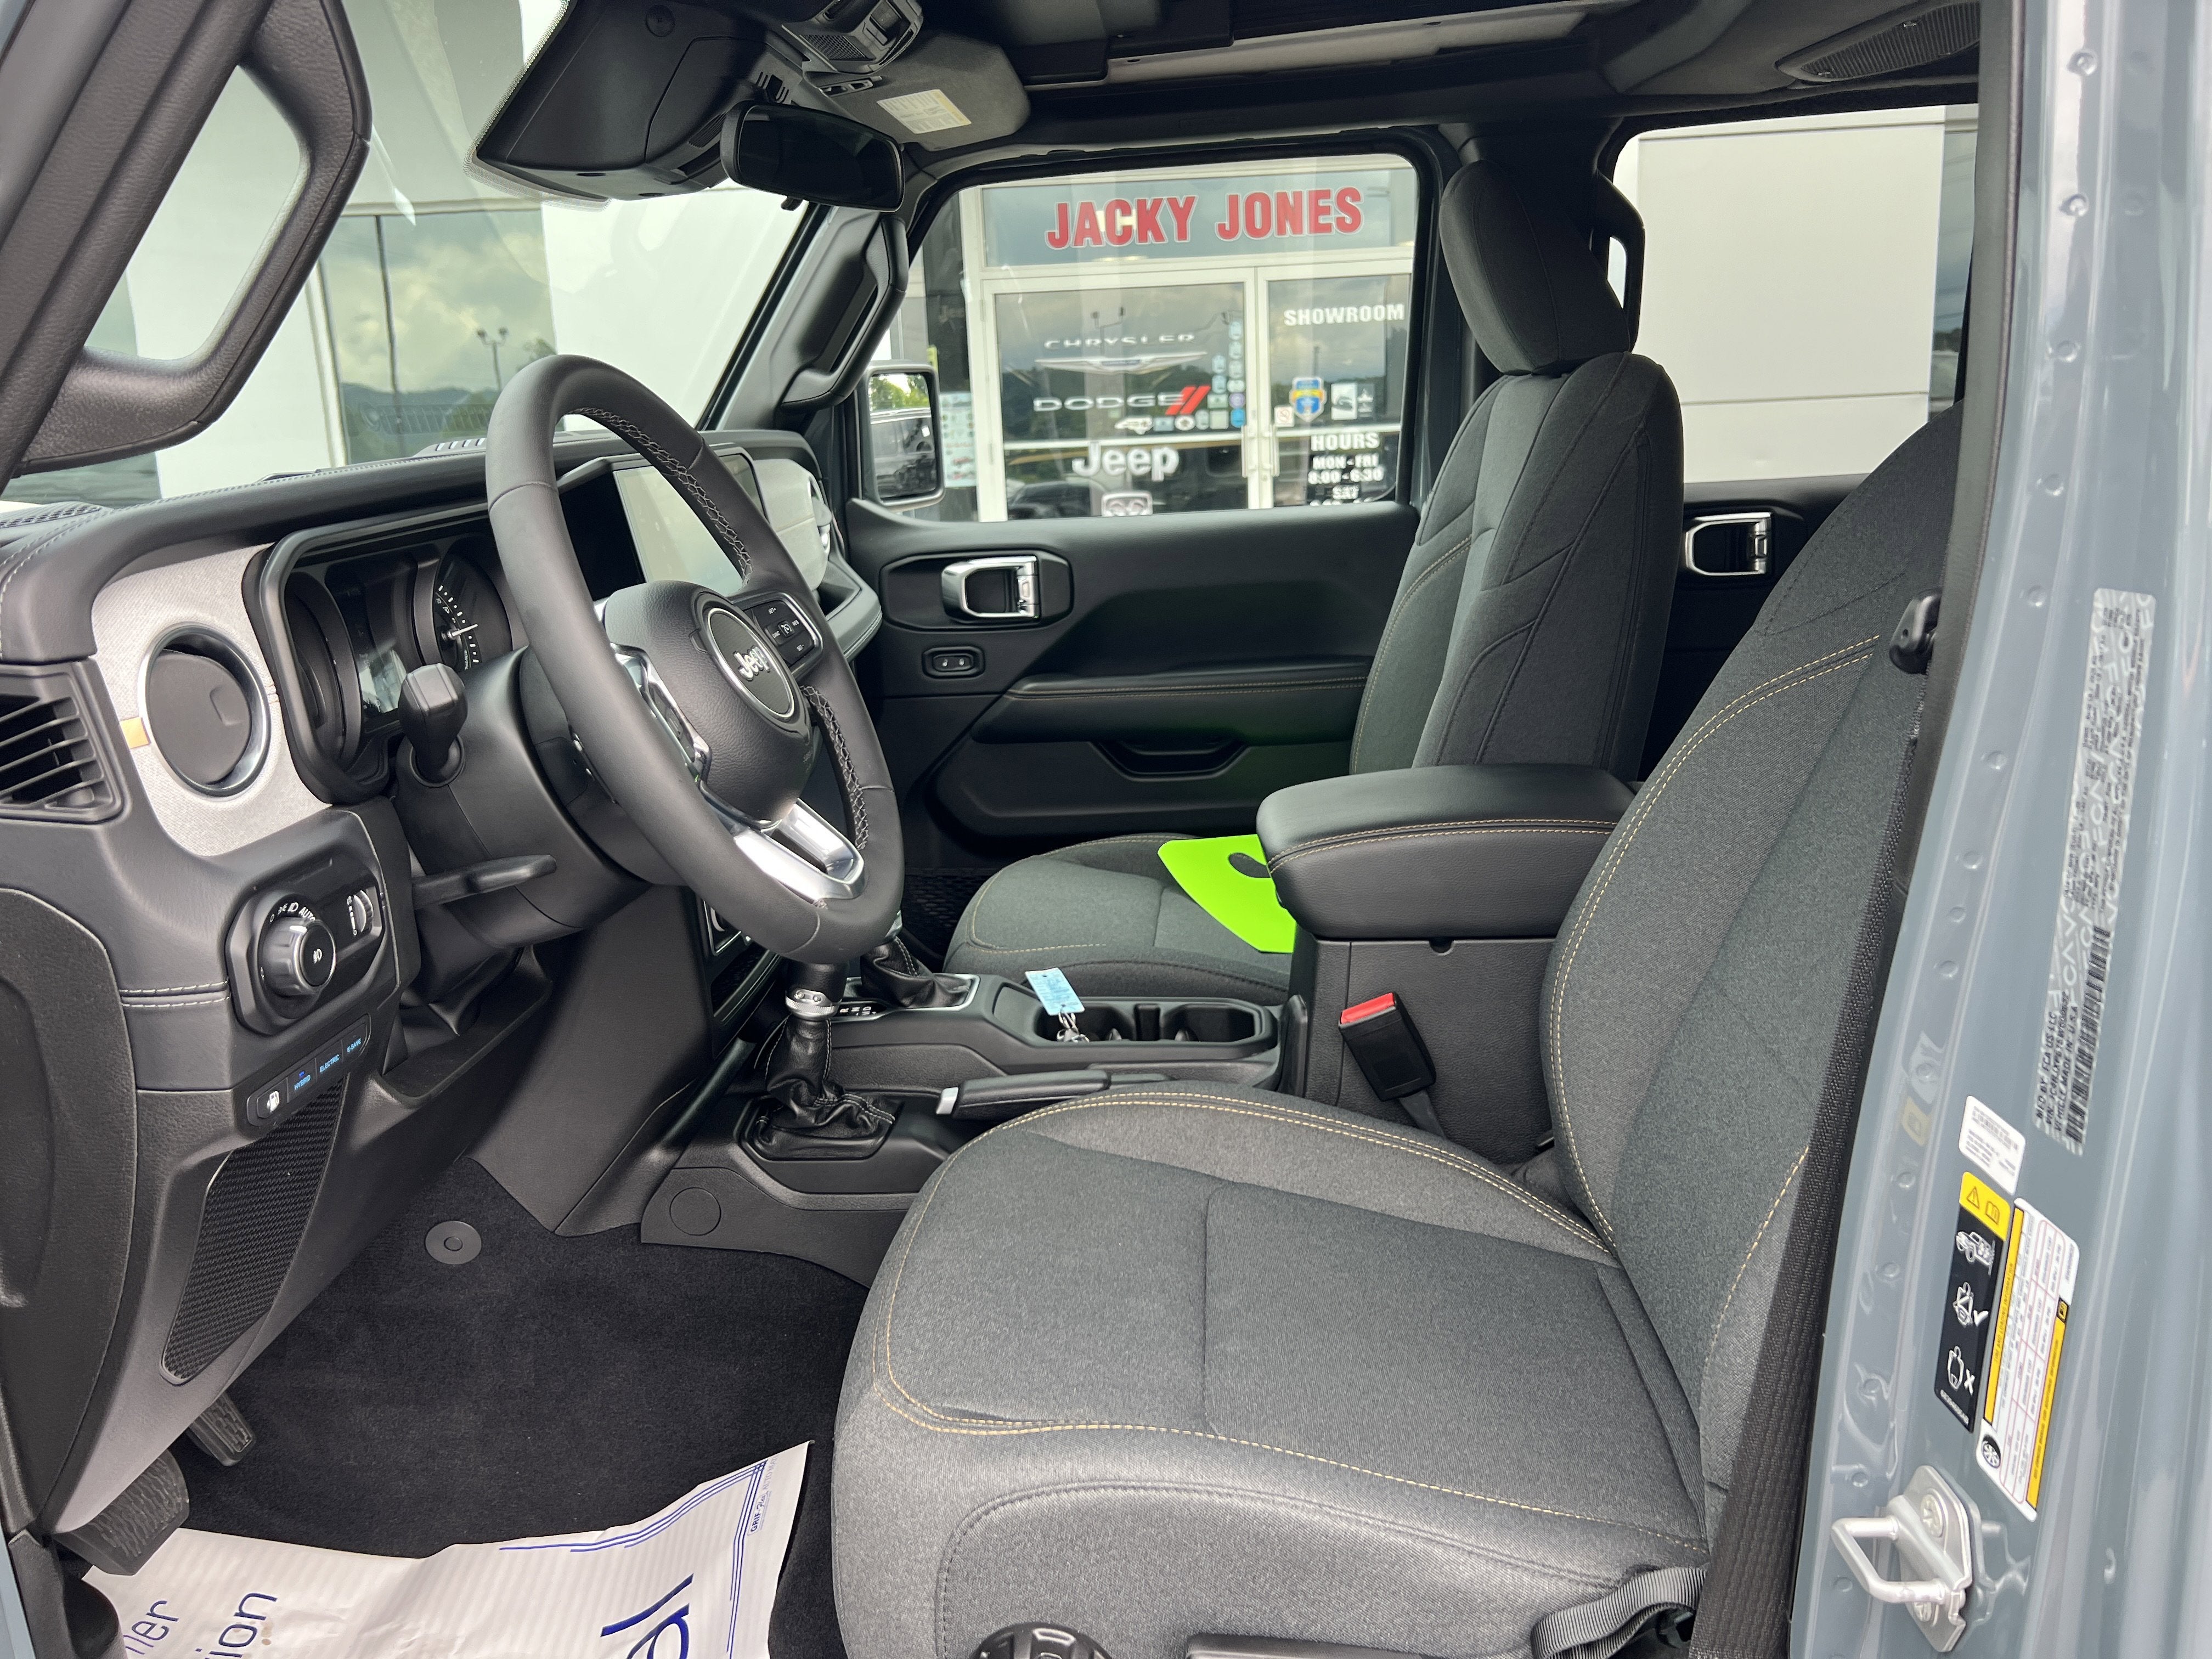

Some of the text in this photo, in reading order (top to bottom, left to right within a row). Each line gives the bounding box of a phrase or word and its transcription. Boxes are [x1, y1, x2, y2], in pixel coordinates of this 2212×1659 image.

[1045, 186, 1364, 250] JACKY JONES
[1283, 303, 1405, 326] SHOWROOM
[1044, 333, 1195, 349] CHRYSLER
[1033, 391, 1185, 412] DODGE
[1311, 432, 1380, 452] HOURS
[1071, 441, 1180, 482] Jeep
[732, 645, 771, 681] Jeep
[298, 906, 316, 921] AUTO
